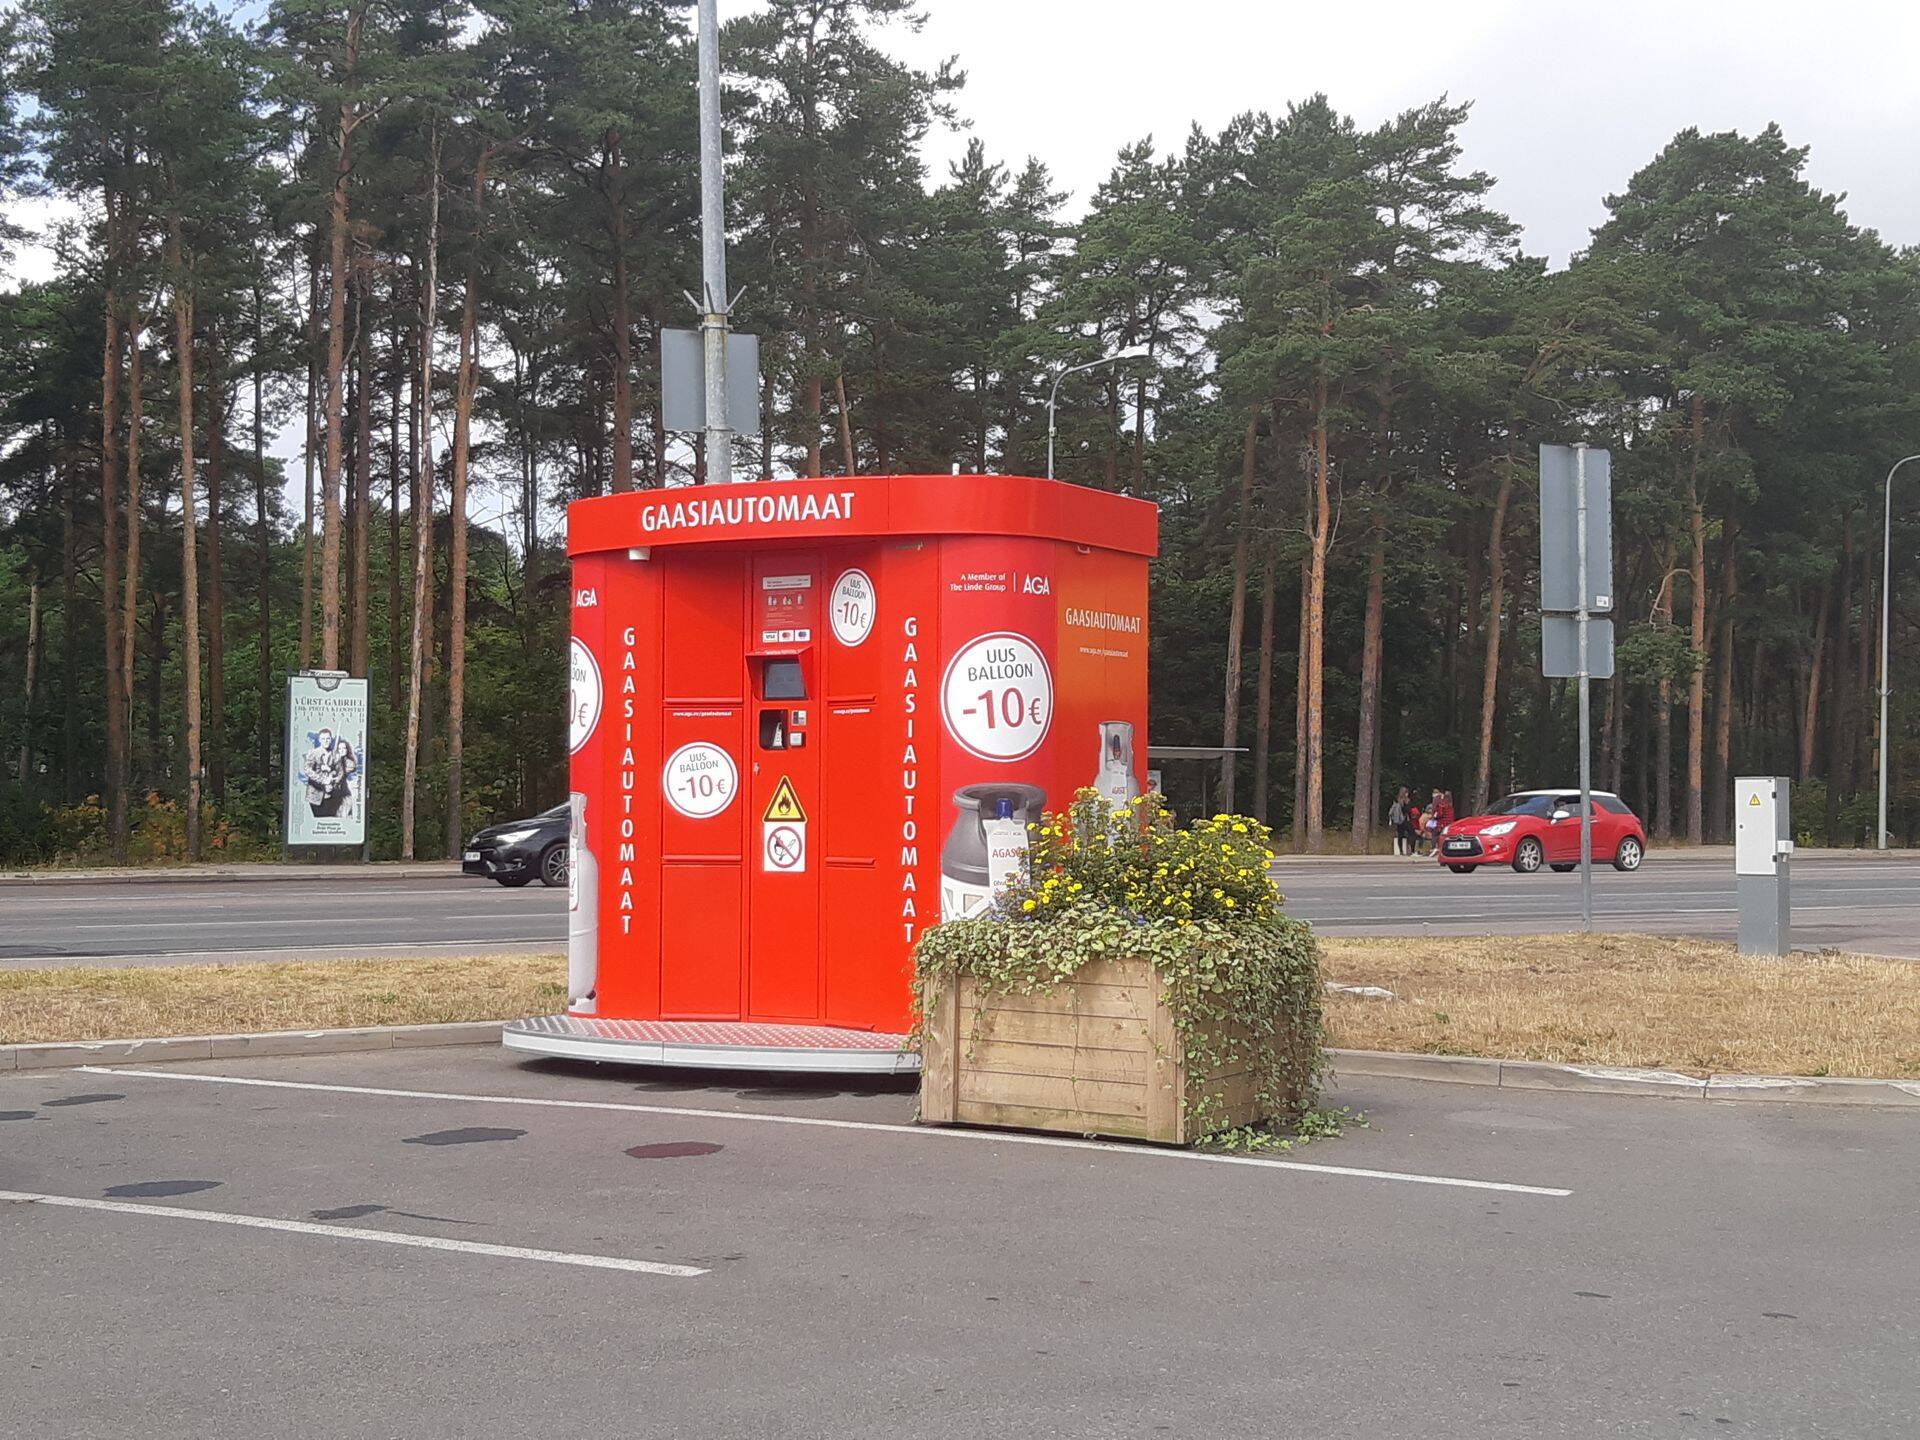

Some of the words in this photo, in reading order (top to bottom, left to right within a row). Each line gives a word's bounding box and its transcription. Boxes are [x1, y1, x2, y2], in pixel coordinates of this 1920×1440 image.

[641, 492, 855, 532] GAASIAUTOMAAT
[849, 578, 862, 589] UUS
[967, 572, 997, 581] Member
[998, 572, 1006, 580] of
[1022, 573, 1050, 595] AGA
[841, 586, 868, 600] BALLOON
[949, 583, 962, 591] The
[963, 583, 983, 591] Linde
[984, 583, 1006, 593] Group
[576, 587, 598, 607] AGA
[1065, 607, 1142, 634] GAASIAUTOMAAT
[986, 647, 1017, 664] UUS
[967, 662, 1034, 682] BALLOON
[689, 753, 707, 763] UUS
[679, 760, 719, 773] BALLOON
